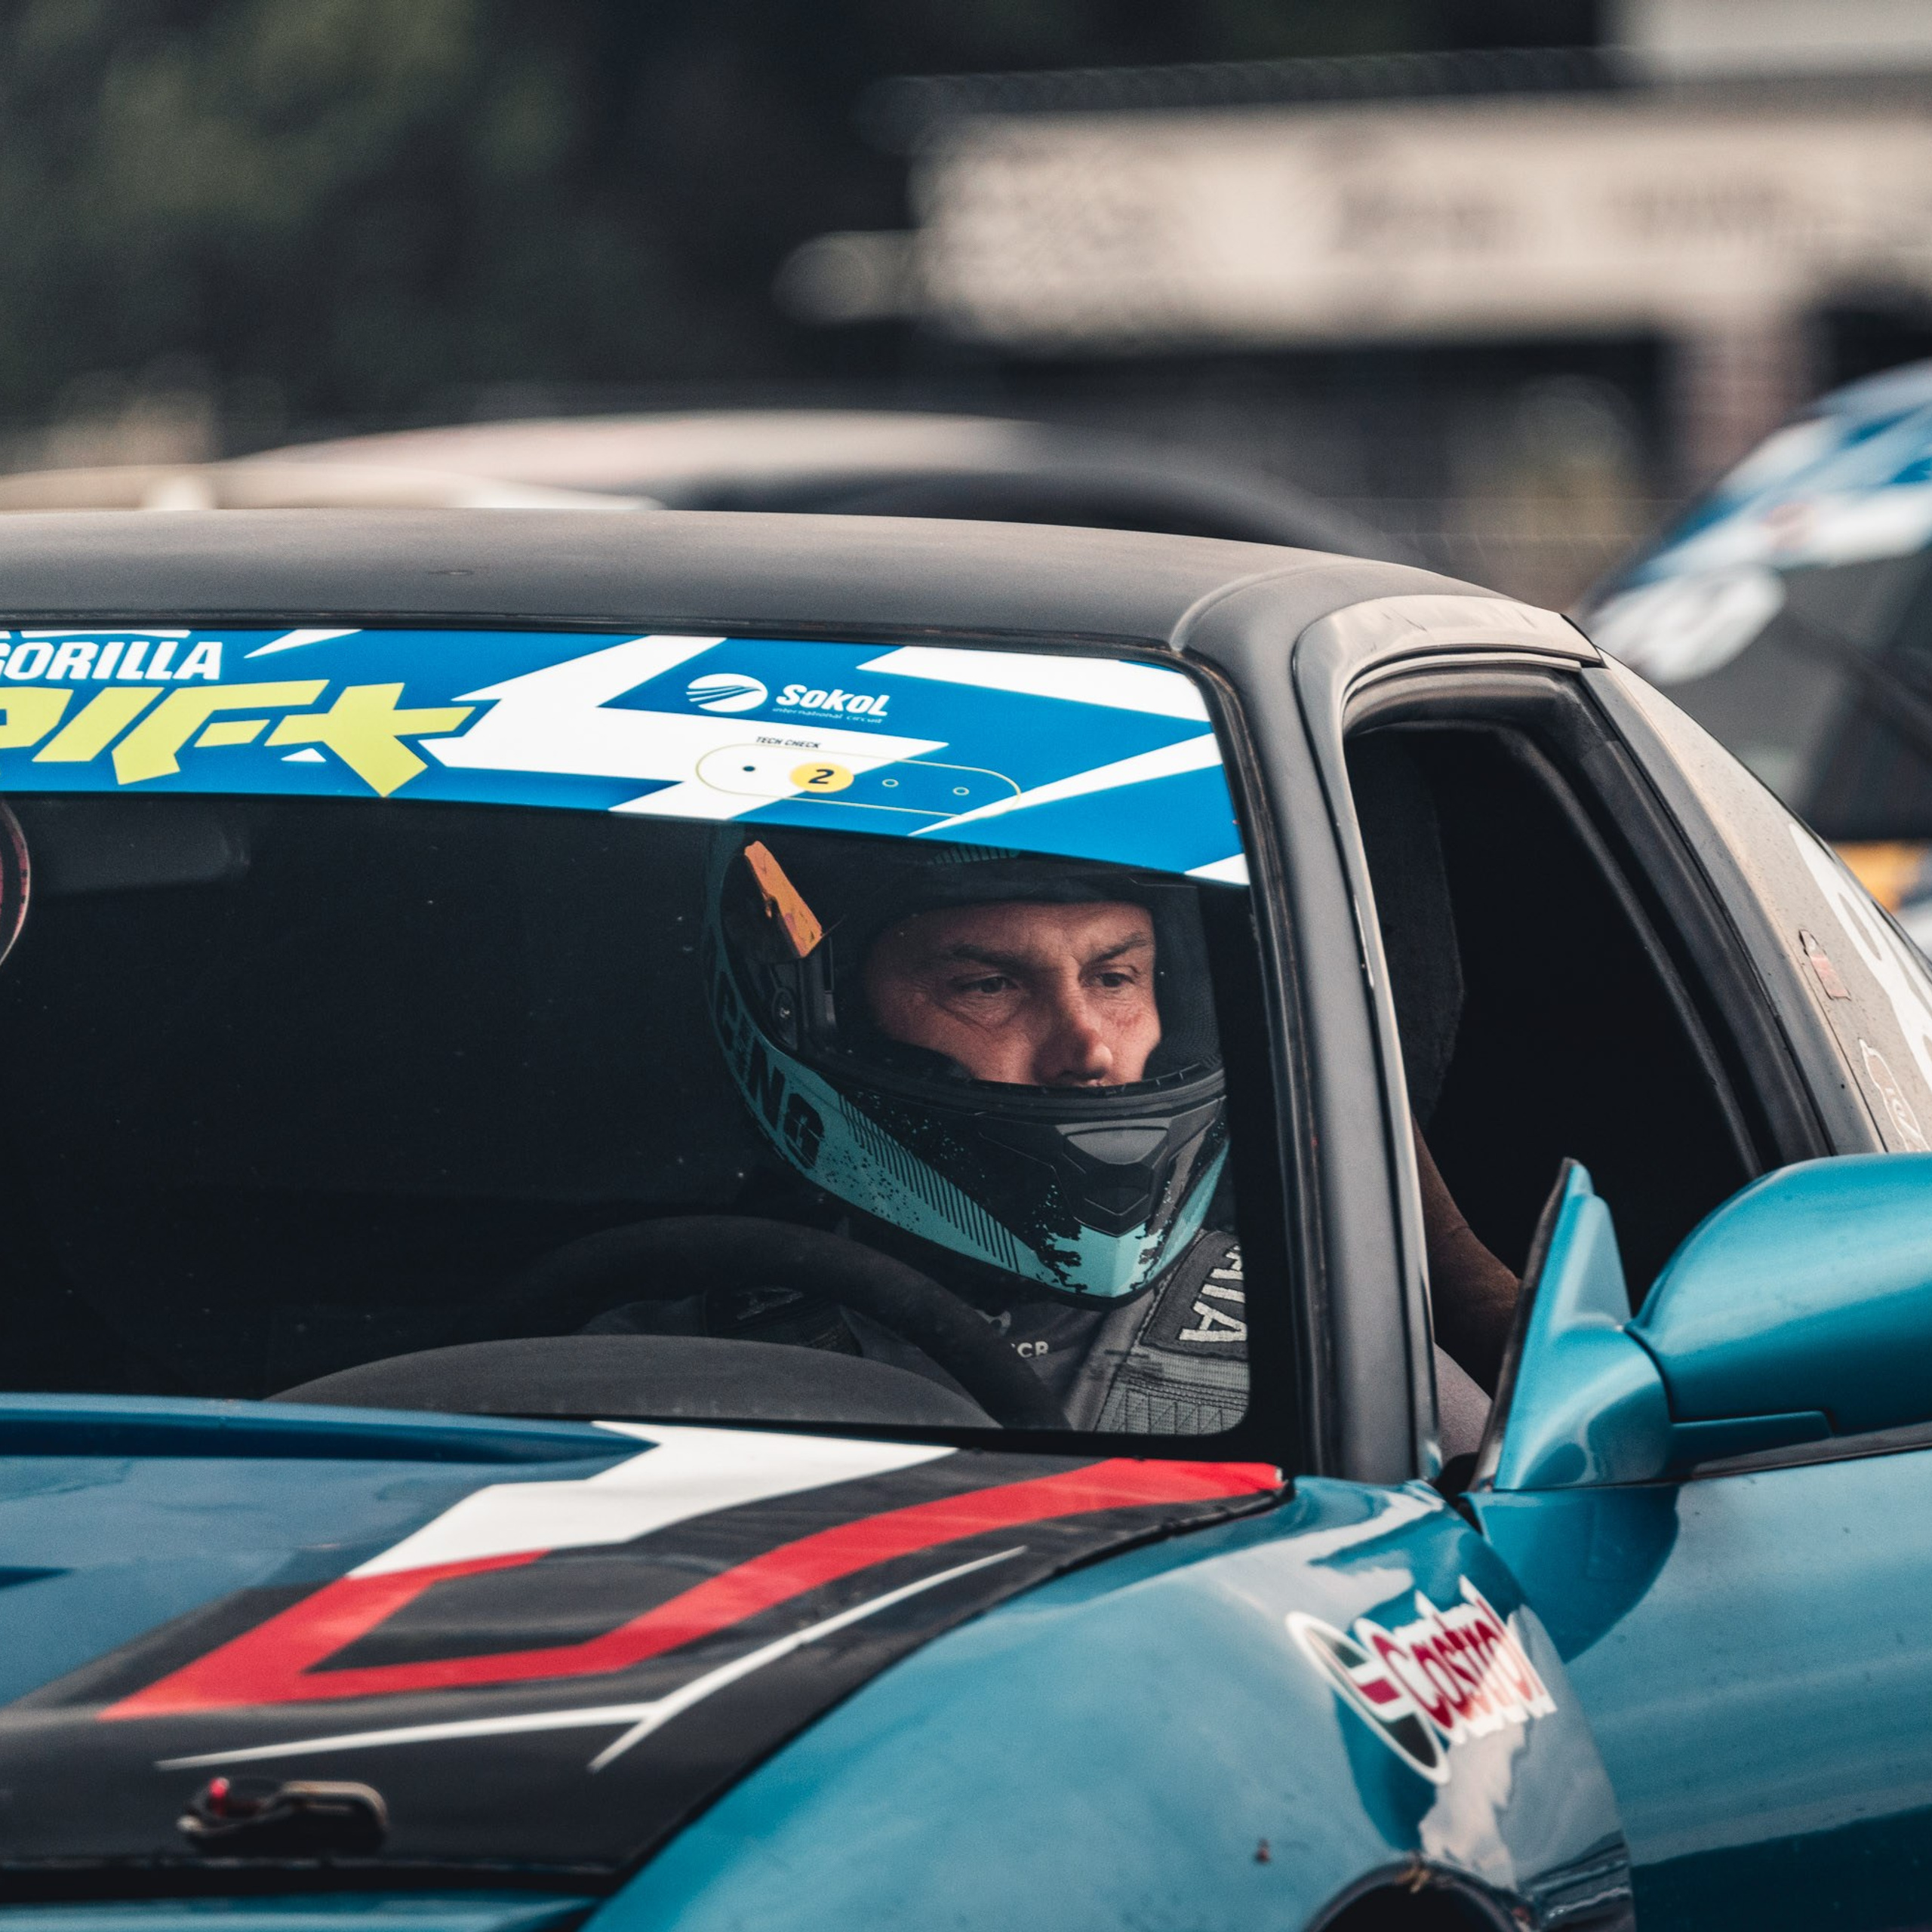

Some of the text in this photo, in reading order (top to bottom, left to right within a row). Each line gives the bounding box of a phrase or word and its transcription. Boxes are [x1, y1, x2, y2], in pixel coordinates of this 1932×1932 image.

[0, 641, 223, 680] ORILLA
[756, 736, 821, 749] TECH CHECK
[808, 769, 835, 785] 2
[1364, 1589, 1550, 1736] Castrol
